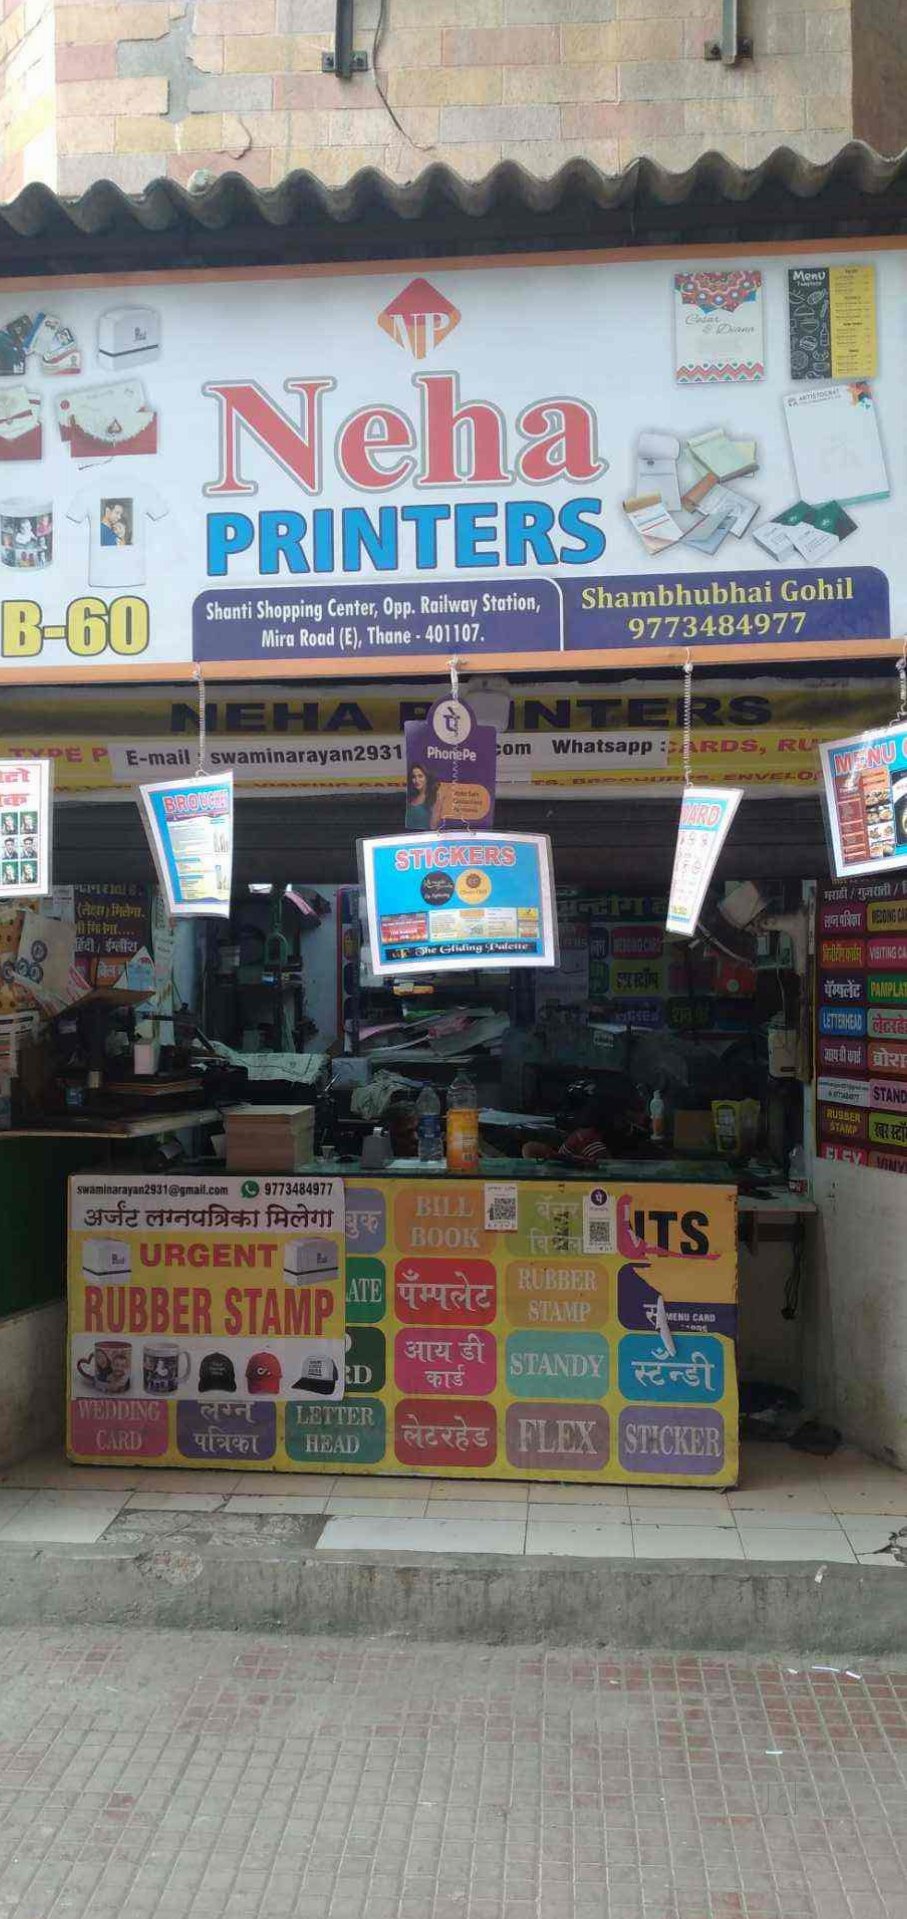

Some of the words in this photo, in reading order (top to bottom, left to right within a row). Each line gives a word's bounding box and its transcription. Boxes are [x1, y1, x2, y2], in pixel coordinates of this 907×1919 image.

[201, 370, 609, 497] Neha
[206, 498, 606, 577] PRINTERS
[581, 581, 773, 610] Shambhubhai
[781, 577, 853, 601] Gohil
[206, 600, 252, 621] Shanti
[257, 598, 323, 623] Shopping
[327, 598, 379, 620] Center,
[383, 597, 415, 619] Opp.
[421, 595, 477, 617] Railway
[482, 593, 541, 615] Station,
[1, 595, 150, 657] B-60
[261, 628, 295, 648] Mira
[301, 627, 335, 646] Road
[339, 627, 363, 651] (E),
[367, 626, 411, 645] Thane
[425, 624, 485, 643] 401107.
[628, 612, 808, 640] 9773484977
[170, 702, 373, 732] NEHA
[126, 749, 190, 766] E-mail
[552, 737, 652, 758] Whatsapp
[427, 746, 478, 762] PhonePe
[395, 846, 516, 871] STICKERS
[77, 1183, 228, 1197] swaminarayan2931@gmail.com
[264, 1182, 333, 1197] 9773484977
[146, 1203, 260, 1228] लग्नपत्रिका
[267, 1203, 334, 1229] मिलेगा
[415, 1195, 475, 1218] BILL
[410, 1226, 482, 1249] BOOK
[139, 1243, 278, 1268] URGENT
[518, 1267, 598, 1292] RUBBER
[84, 1286, 212, 1334] RUBBER
[224, 1287, 335, 1336] STAMP
[527, 1299, 592, 1323] STAMP
[692, 1313, 716, 1322] CARD
[403, 1340, 453, 1364] आय
[458, 1333, 486, 1364] डी
[424, 1365, 467, 1389] कार्ड
[509, 1353, 605, 1378] STANDY
[76, 1400, 161, 1422] WEDDING
[295, 1405, 376, 1426] LETTER
[95, 1429, 143, 1450] CARD
[193, 1426, 260, 1455] पत्रिका
[304, 1432, 361, 1454] HEAD
[400, 1413, 492, 1450] लेटरहेड
[517, 1418, 599, 1455] FLEX
[624, 1423, 723, 1458] STICKER
